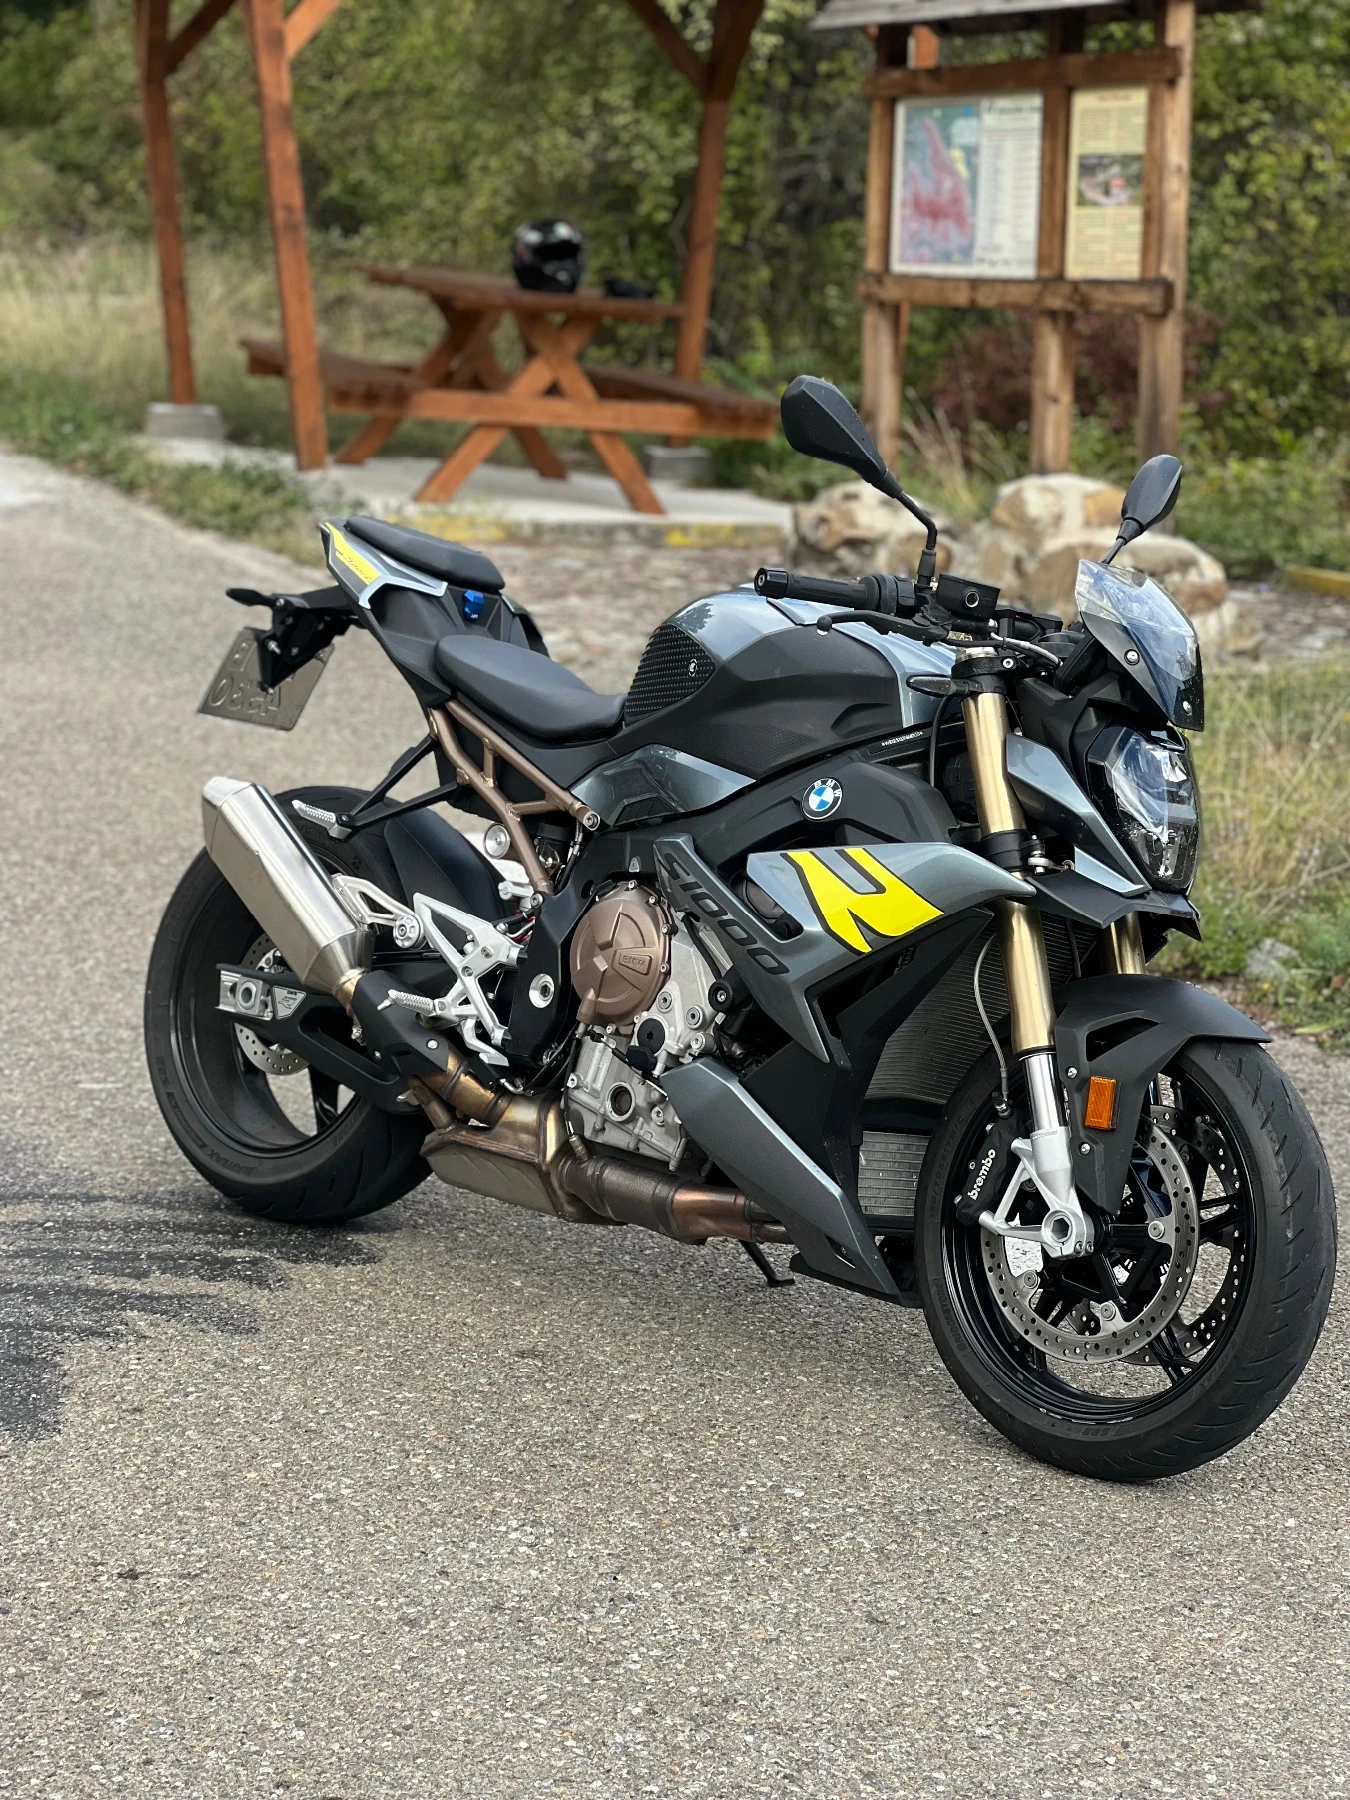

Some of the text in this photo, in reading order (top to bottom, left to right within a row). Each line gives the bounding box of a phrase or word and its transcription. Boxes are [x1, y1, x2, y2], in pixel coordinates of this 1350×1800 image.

[657, 852, 791, 976] S1000
[622, 954, 646, 969] BMW
[967, 1148, 996, 1201] brembo
